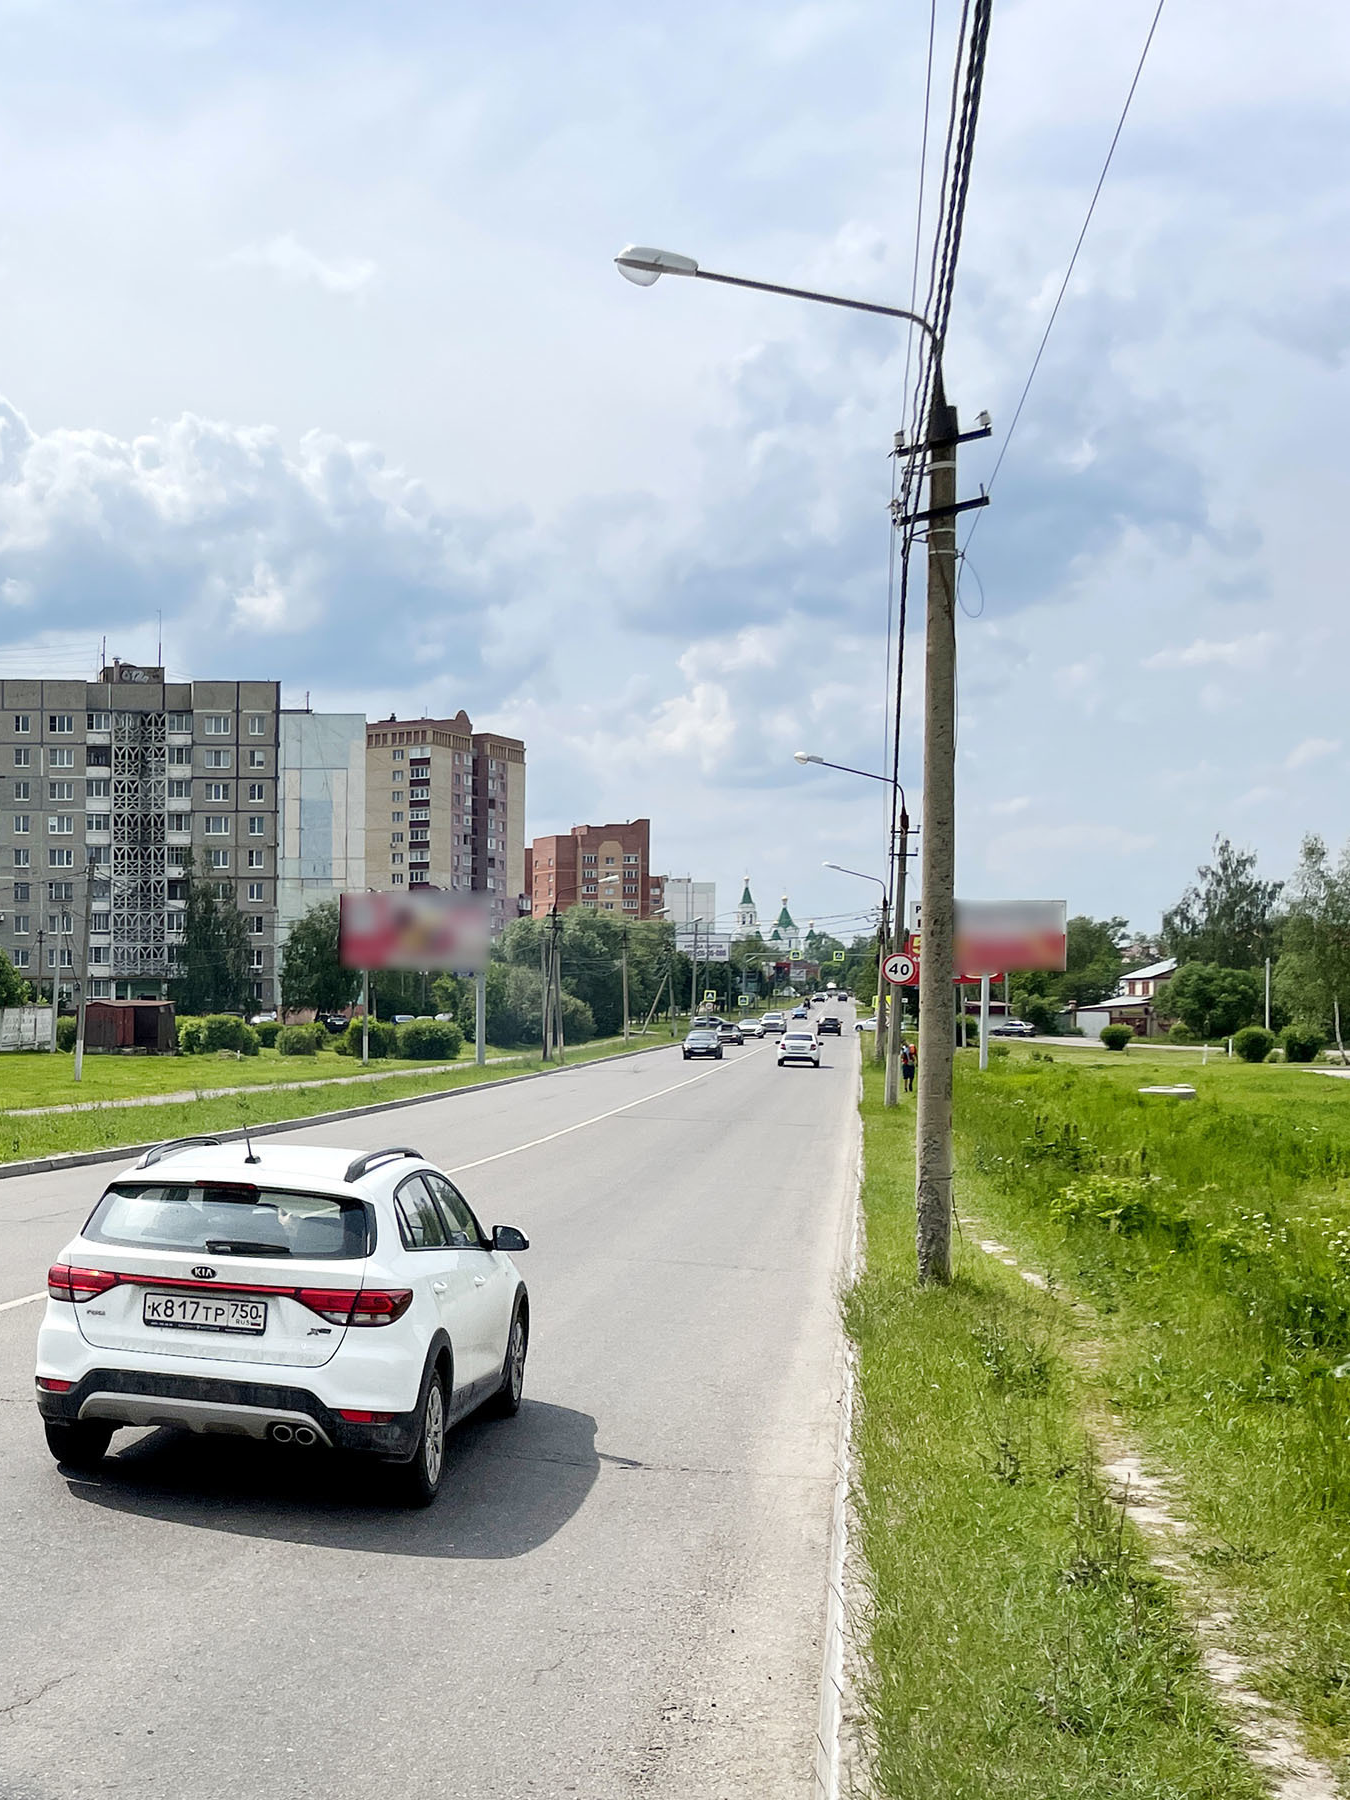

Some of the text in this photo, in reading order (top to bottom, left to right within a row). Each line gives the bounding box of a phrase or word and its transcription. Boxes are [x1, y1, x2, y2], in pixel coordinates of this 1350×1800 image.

[888, 963, 909, 976] 40
[194, 1267, 213, 1277] KIA
[230, 1303, 260, 1320] 750
[235, 1318, 250, 1326] RUS
